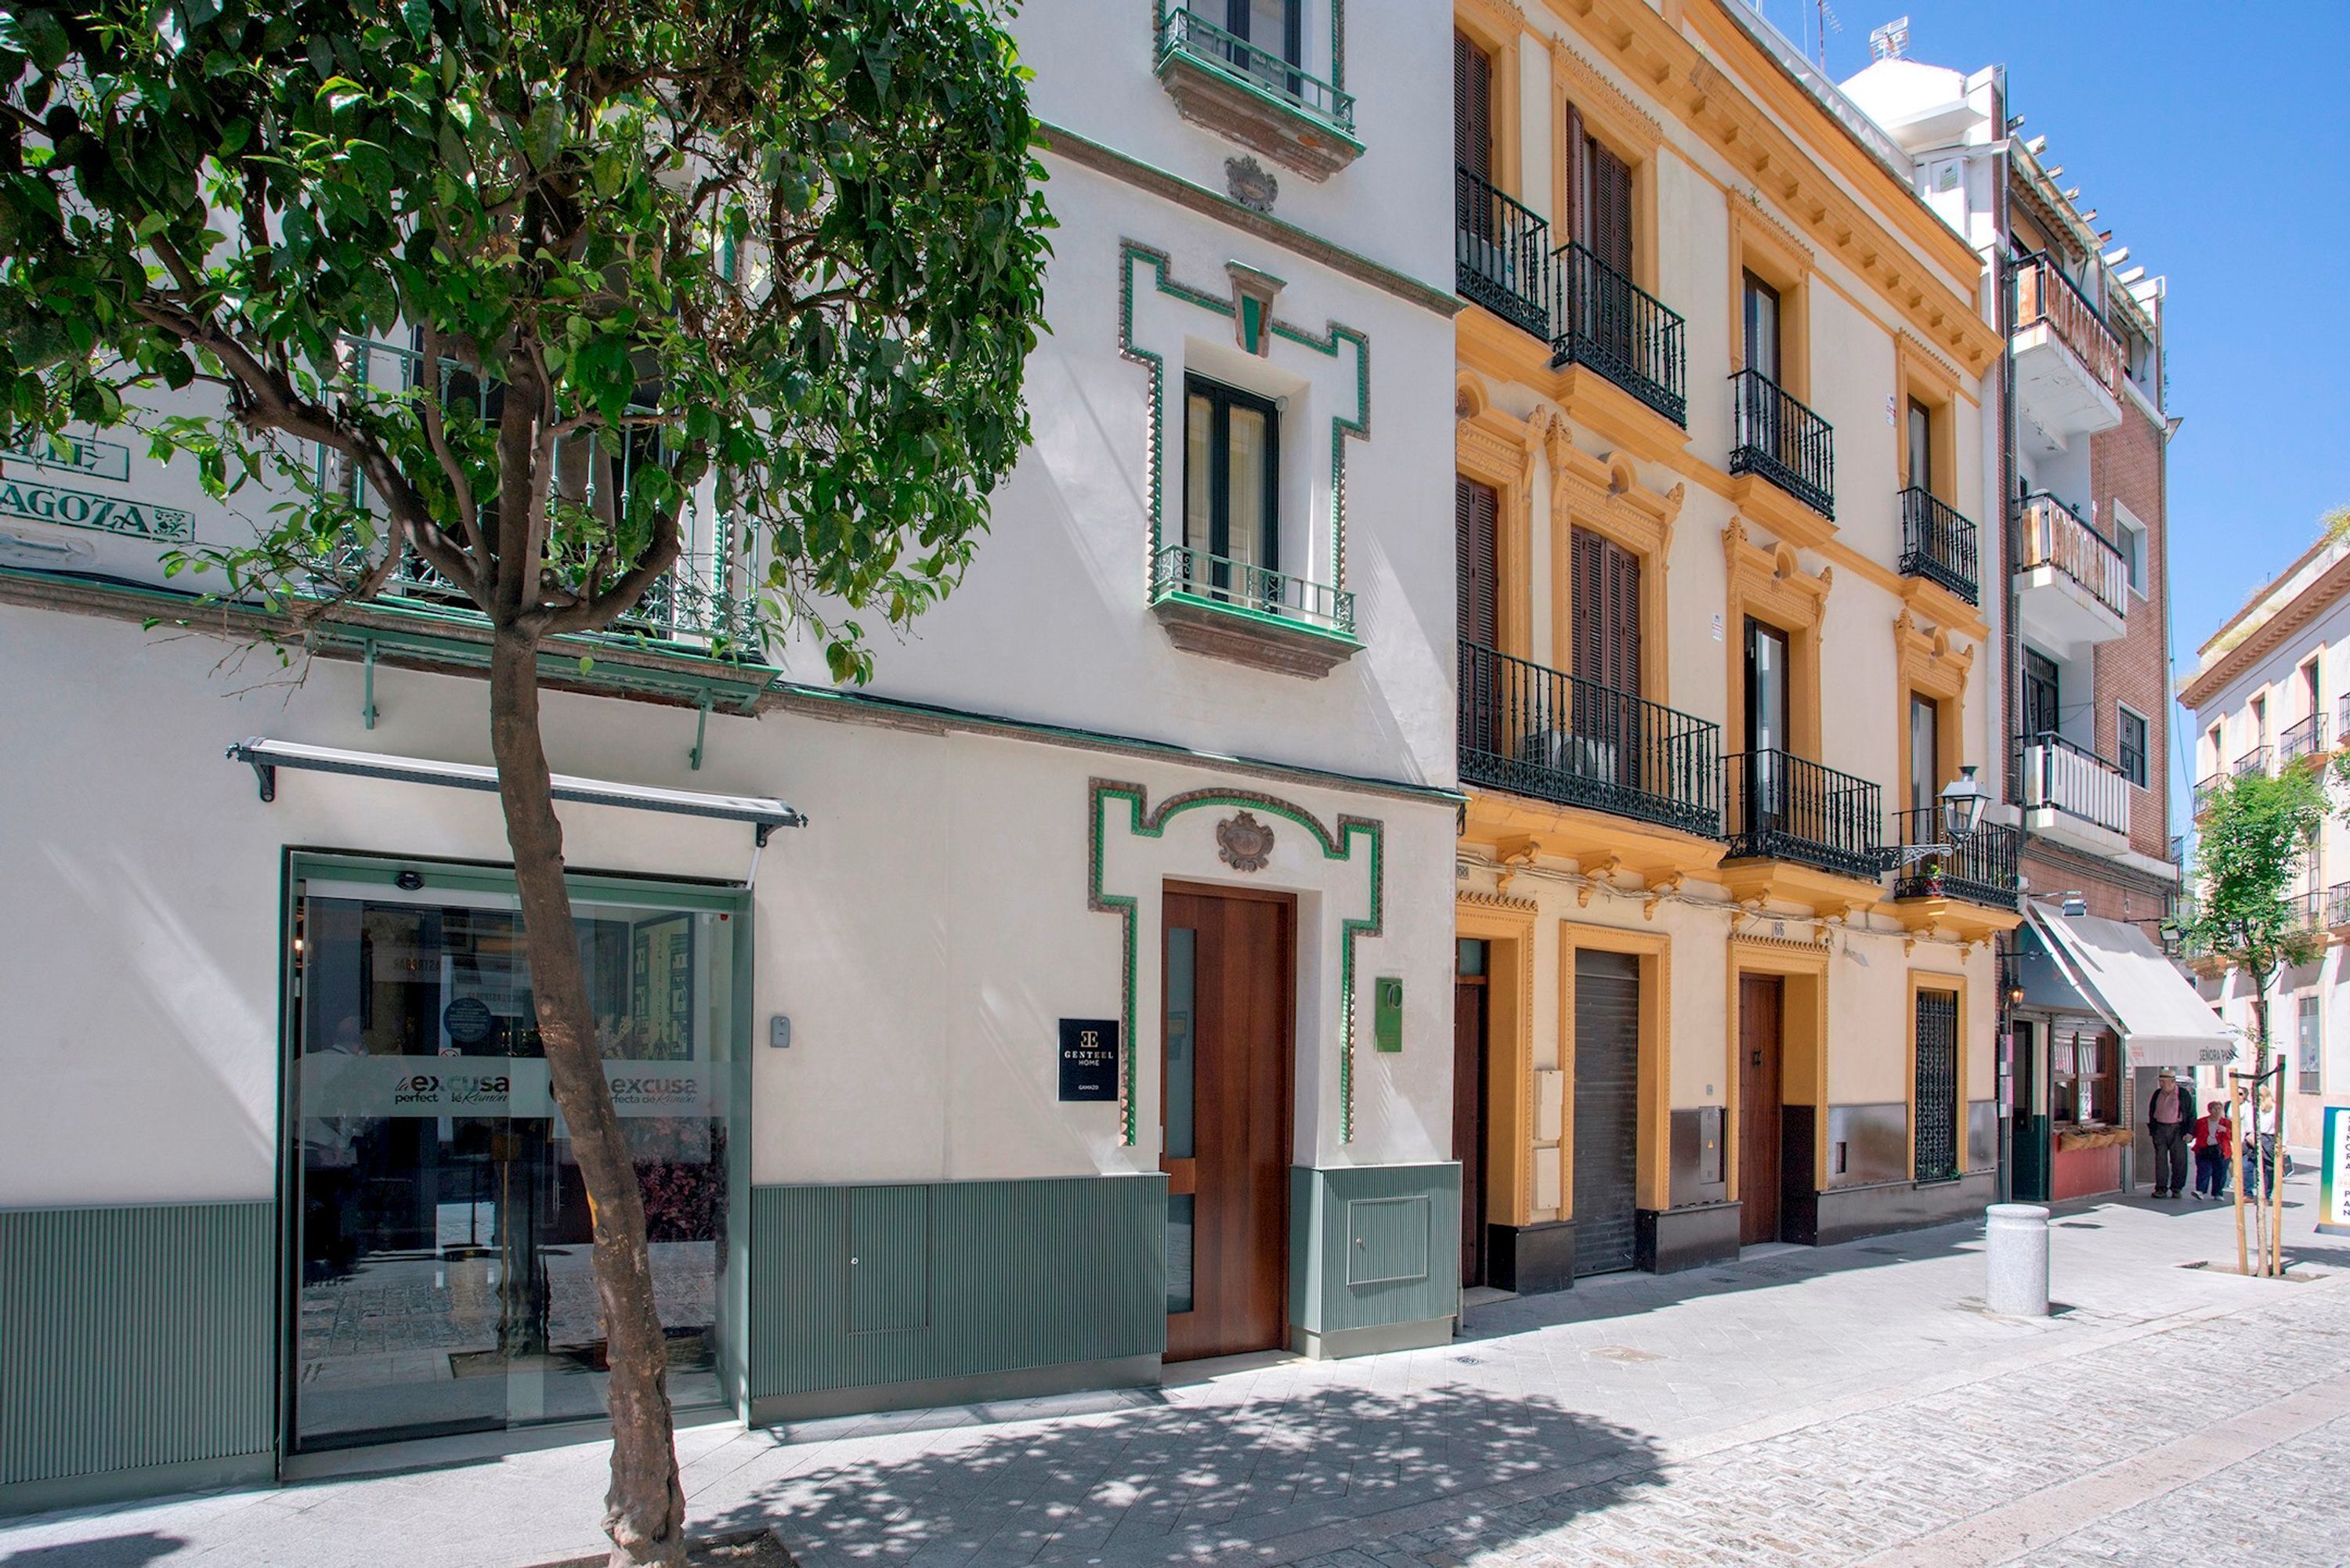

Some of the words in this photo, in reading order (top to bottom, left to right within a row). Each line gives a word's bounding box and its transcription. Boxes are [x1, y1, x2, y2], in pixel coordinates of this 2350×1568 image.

[1382, 981, 1402, 1009] 70
[1065, 1050, 1114, 1059] GENTEEL
[610, 1078, 698, 1094] excusa
[395, 1093, 439, 1105] perfect
[612, 1095, 640, 1104] rfecta
